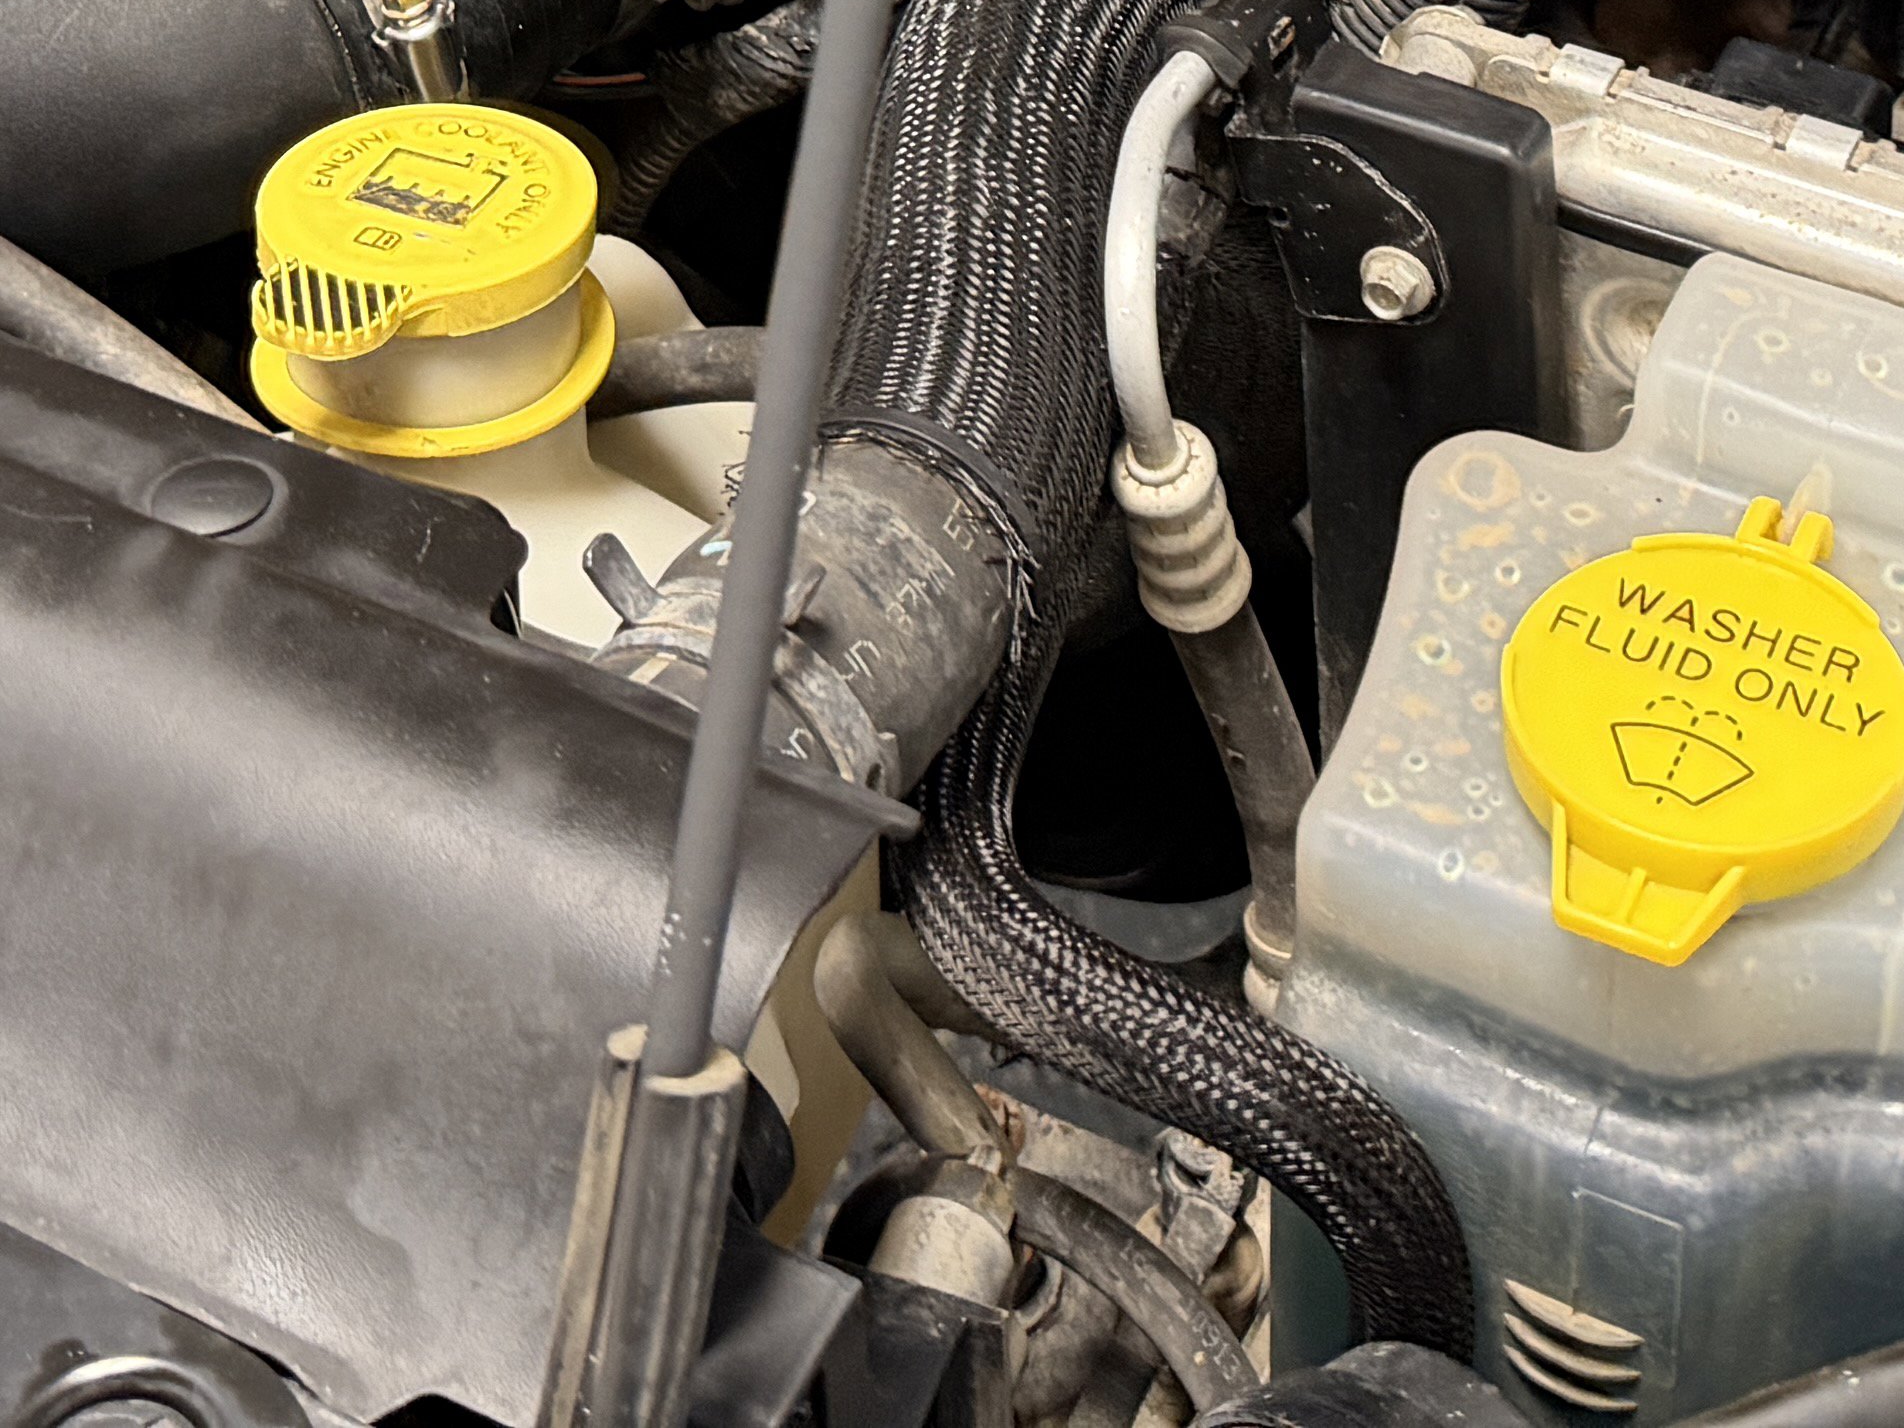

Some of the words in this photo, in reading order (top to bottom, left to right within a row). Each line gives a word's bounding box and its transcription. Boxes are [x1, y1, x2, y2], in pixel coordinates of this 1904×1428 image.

[415, 120, 551, 175] COOLANT
[496, 182, 552, 239] ONLY
[1549, 604, 1714, 683] FLUID
[1734, 665, 1887, 739] ONLY
[1617, 575, 1863, 685] WASHER
